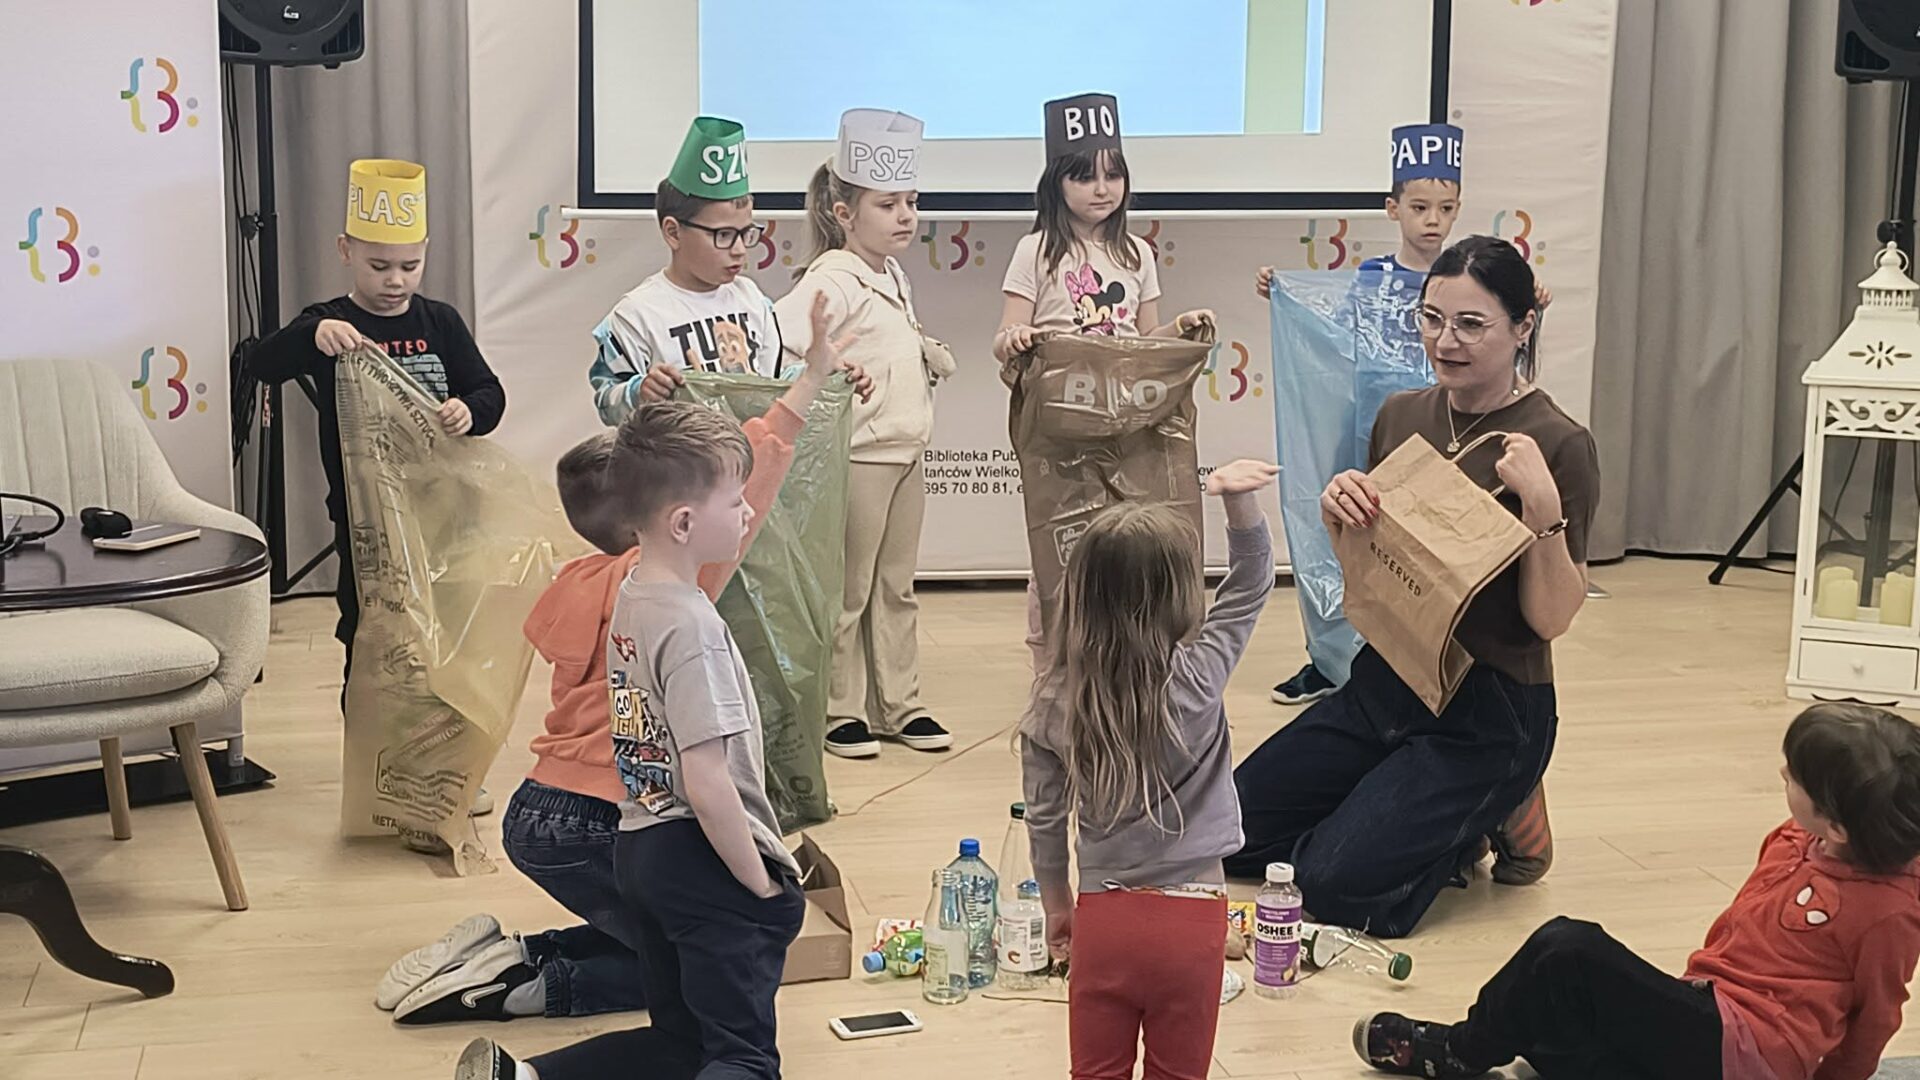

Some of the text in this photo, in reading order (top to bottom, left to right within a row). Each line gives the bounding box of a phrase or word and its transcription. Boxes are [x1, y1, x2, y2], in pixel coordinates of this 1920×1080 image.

[1064, 105, 1115, 141] BIO
[348, 182, 424, 227] PLAS
[1064, 373, 1168, 411] BIO
[924, 449, 1019, 462] Biblioteka Pub
[975, 465, 1020, 479] Wielko
[952, 482, 968, 495] 70
[972, 482, 989, 495] 80
[1370, 541, 1421, 597] RESERVED
[616, 695, 630, 716] GO
[1257, 922, 1294, 936] OSHEE
